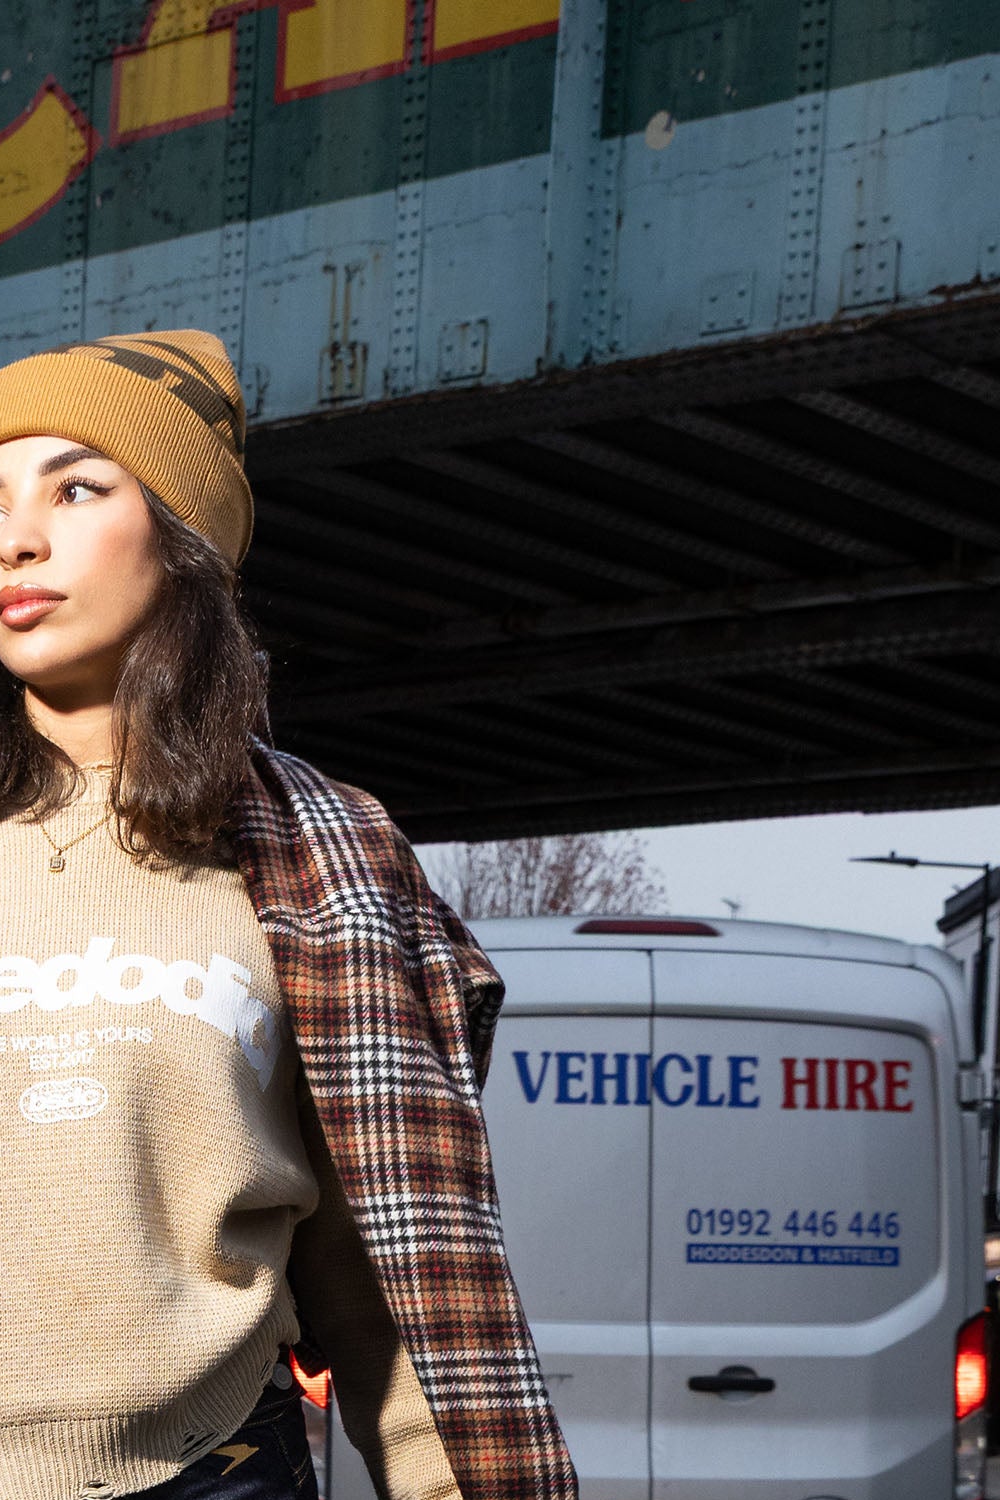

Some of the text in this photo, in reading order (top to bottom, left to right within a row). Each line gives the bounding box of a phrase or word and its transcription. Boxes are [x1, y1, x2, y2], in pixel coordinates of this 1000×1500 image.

[11, 1034, 72, 1051] WORLD
[75, 1029, 91, 1047] IS
[94, 1026, 153, 1044] YOURS
[512, 1051, 914, 1112] VEHICLE HIRE
[686, 1208, 900, 1239] 01992 446 446
[690, 1246, 896, 1265] HODDESDON & HATFIELD
